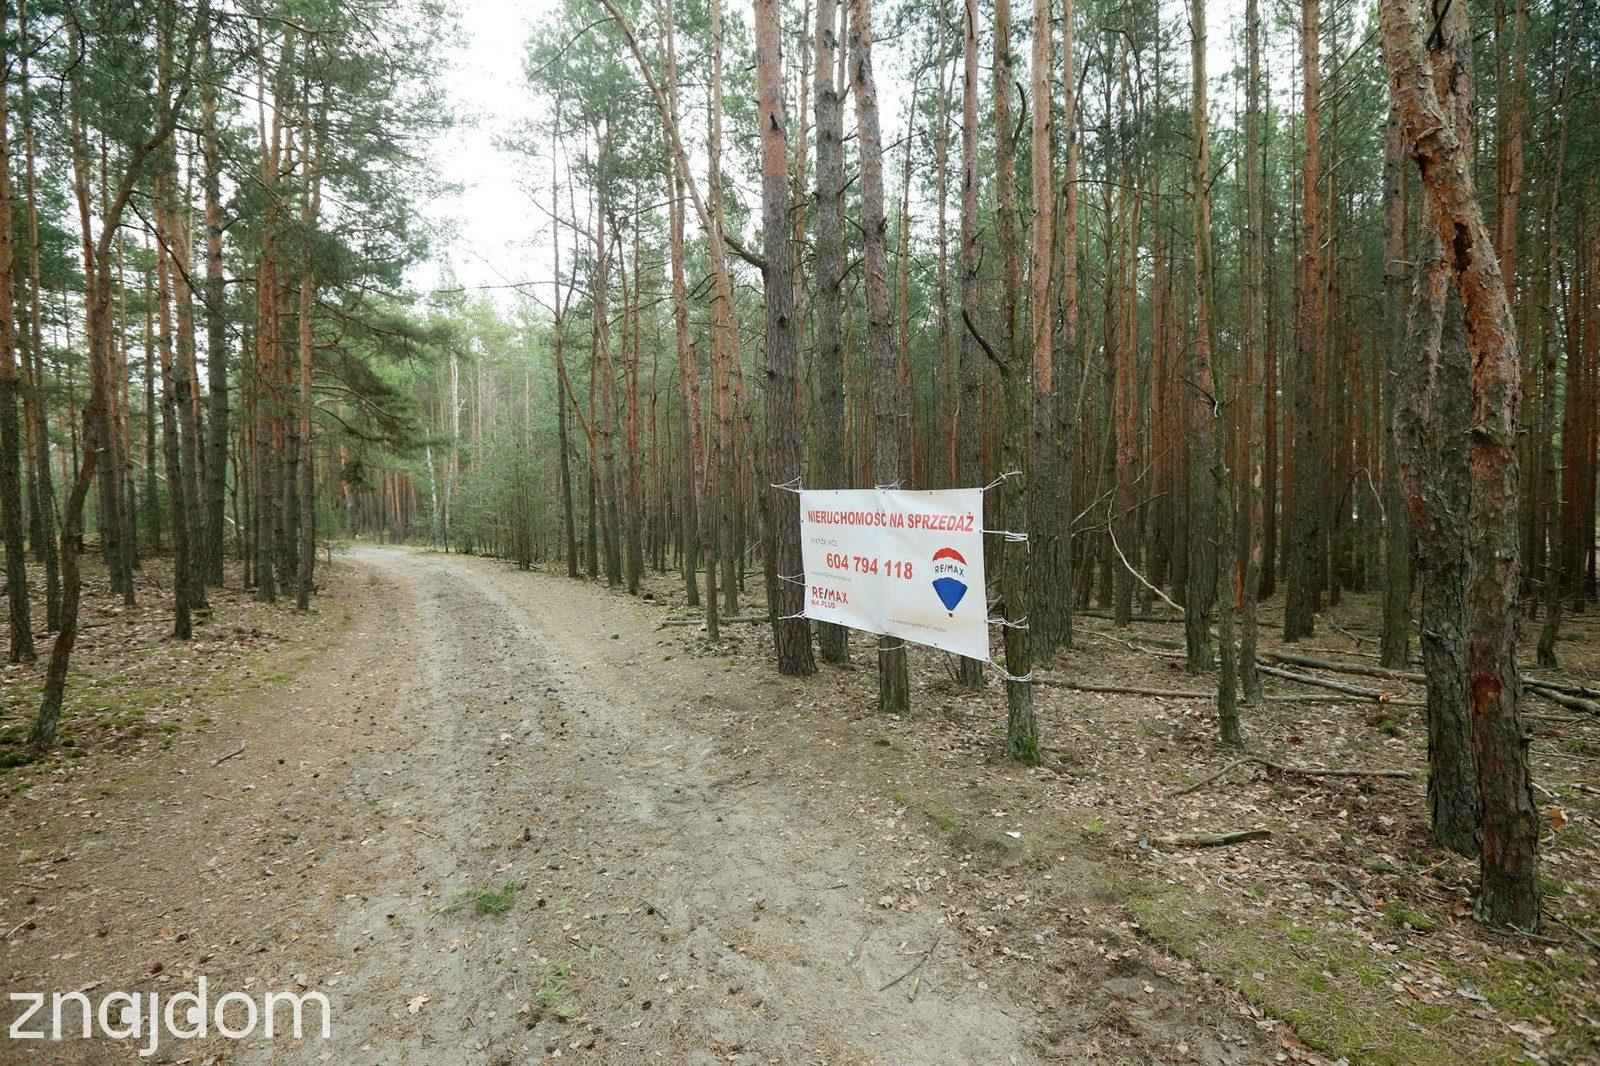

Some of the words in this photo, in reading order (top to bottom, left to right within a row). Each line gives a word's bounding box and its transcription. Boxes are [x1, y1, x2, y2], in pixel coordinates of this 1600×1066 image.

[807, 508, 887, 527] NIERUCHOMOŚĆ
[889, 513, 904, 528] NA
[907, 511, 974, 532] SPRZEDAŻ
[826, 553, 849, 570] 604
[853, 556, 879, 575] 794
[884, 560, 913, 579] 118
[934, 564, 965, 577] RE/MAX
[811, 586, 849, 605] RE/MAX
[821, 600, 836, 609] PLUS
